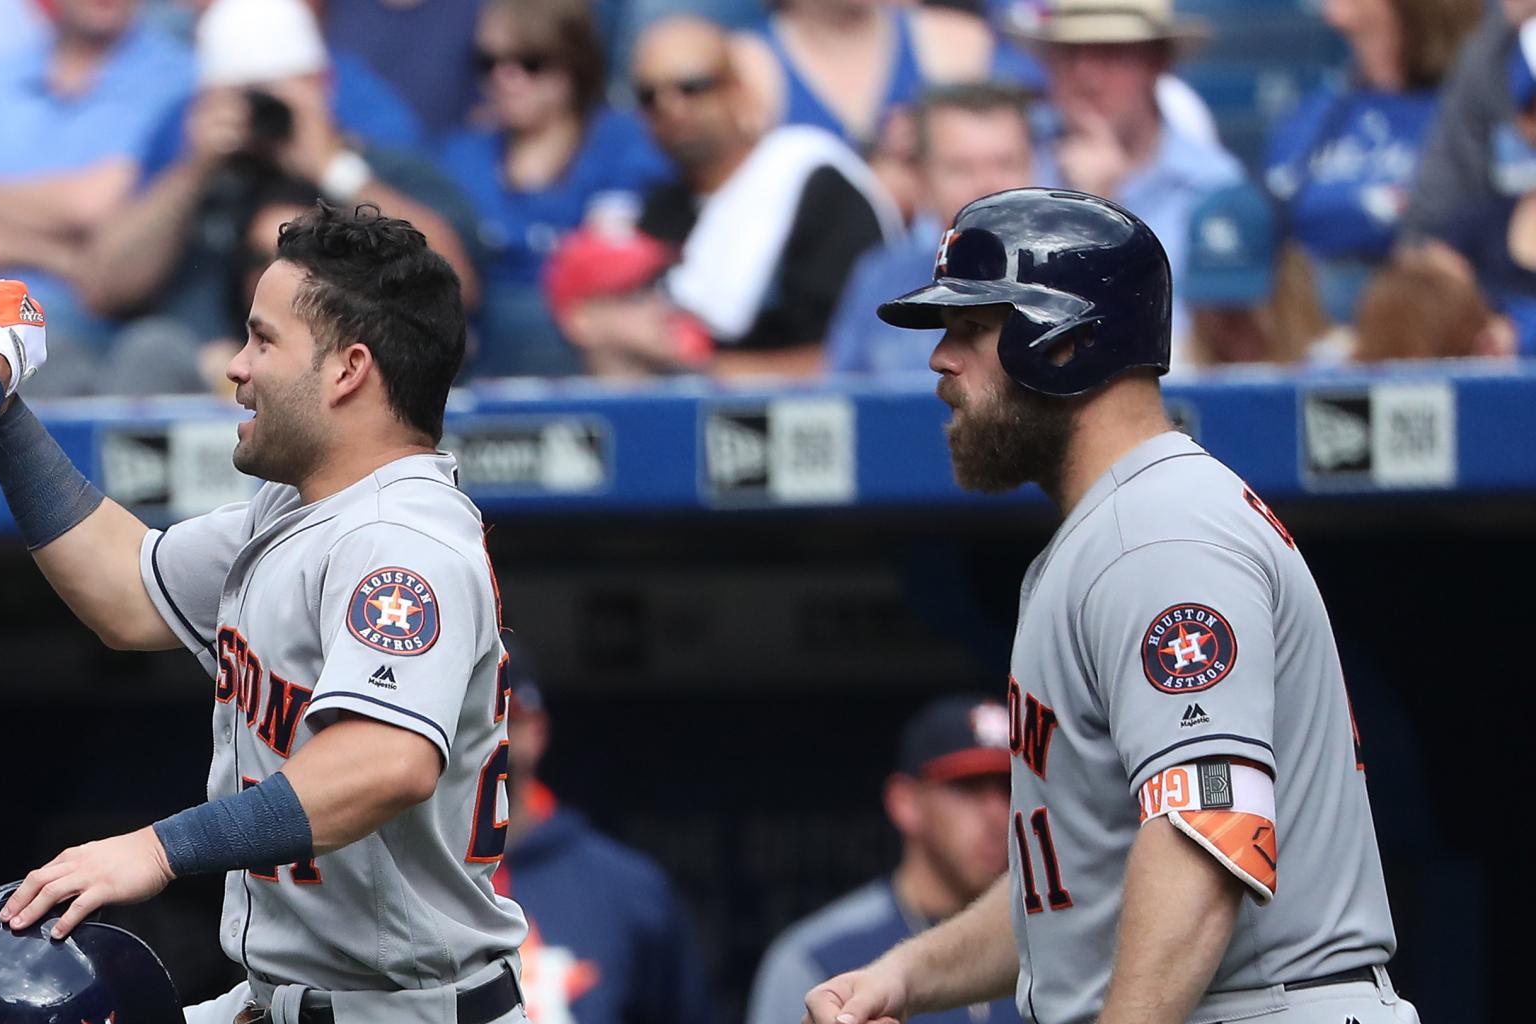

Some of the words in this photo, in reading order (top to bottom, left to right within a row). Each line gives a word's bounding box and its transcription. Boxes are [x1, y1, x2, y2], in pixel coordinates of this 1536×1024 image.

[360, 572, 432, 604] HOUSTON
[376, 595, 413, 629] H
[1148, 609, 1218, 646] HOUSTON
[359, 627, 424, 651] ASTROS
[1168, 632, 1207, 669] H
[368, 677, 398, 690] Majestic
[1163, 661, 1225, 688] ASTROS
[1180, 716, 1210, 728] Majestic
[1015, 806, 1073, 914] 11
